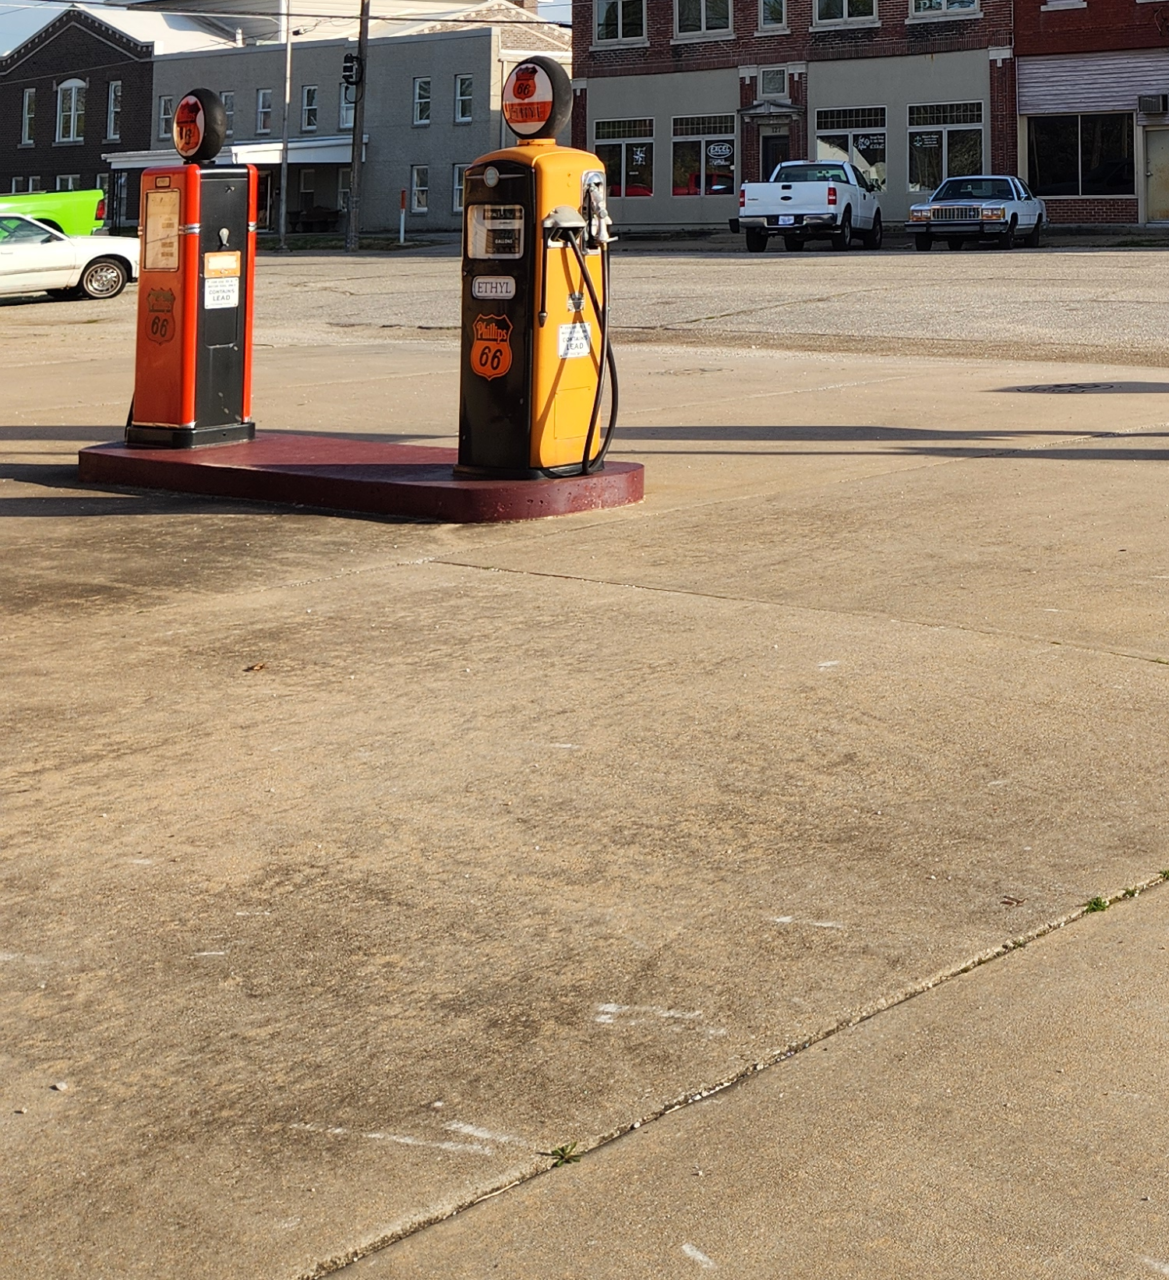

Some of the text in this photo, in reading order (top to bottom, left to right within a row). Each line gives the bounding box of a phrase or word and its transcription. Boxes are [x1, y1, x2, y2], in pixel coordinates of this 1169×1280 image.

[477, 281, 512, 294] ETHYL
[151, 316, 169, 338] 66
[477, 321, 507, 345] Phillips
[566, 343, 584, 351] LEAD
[479, 346, 503, 371] 66
